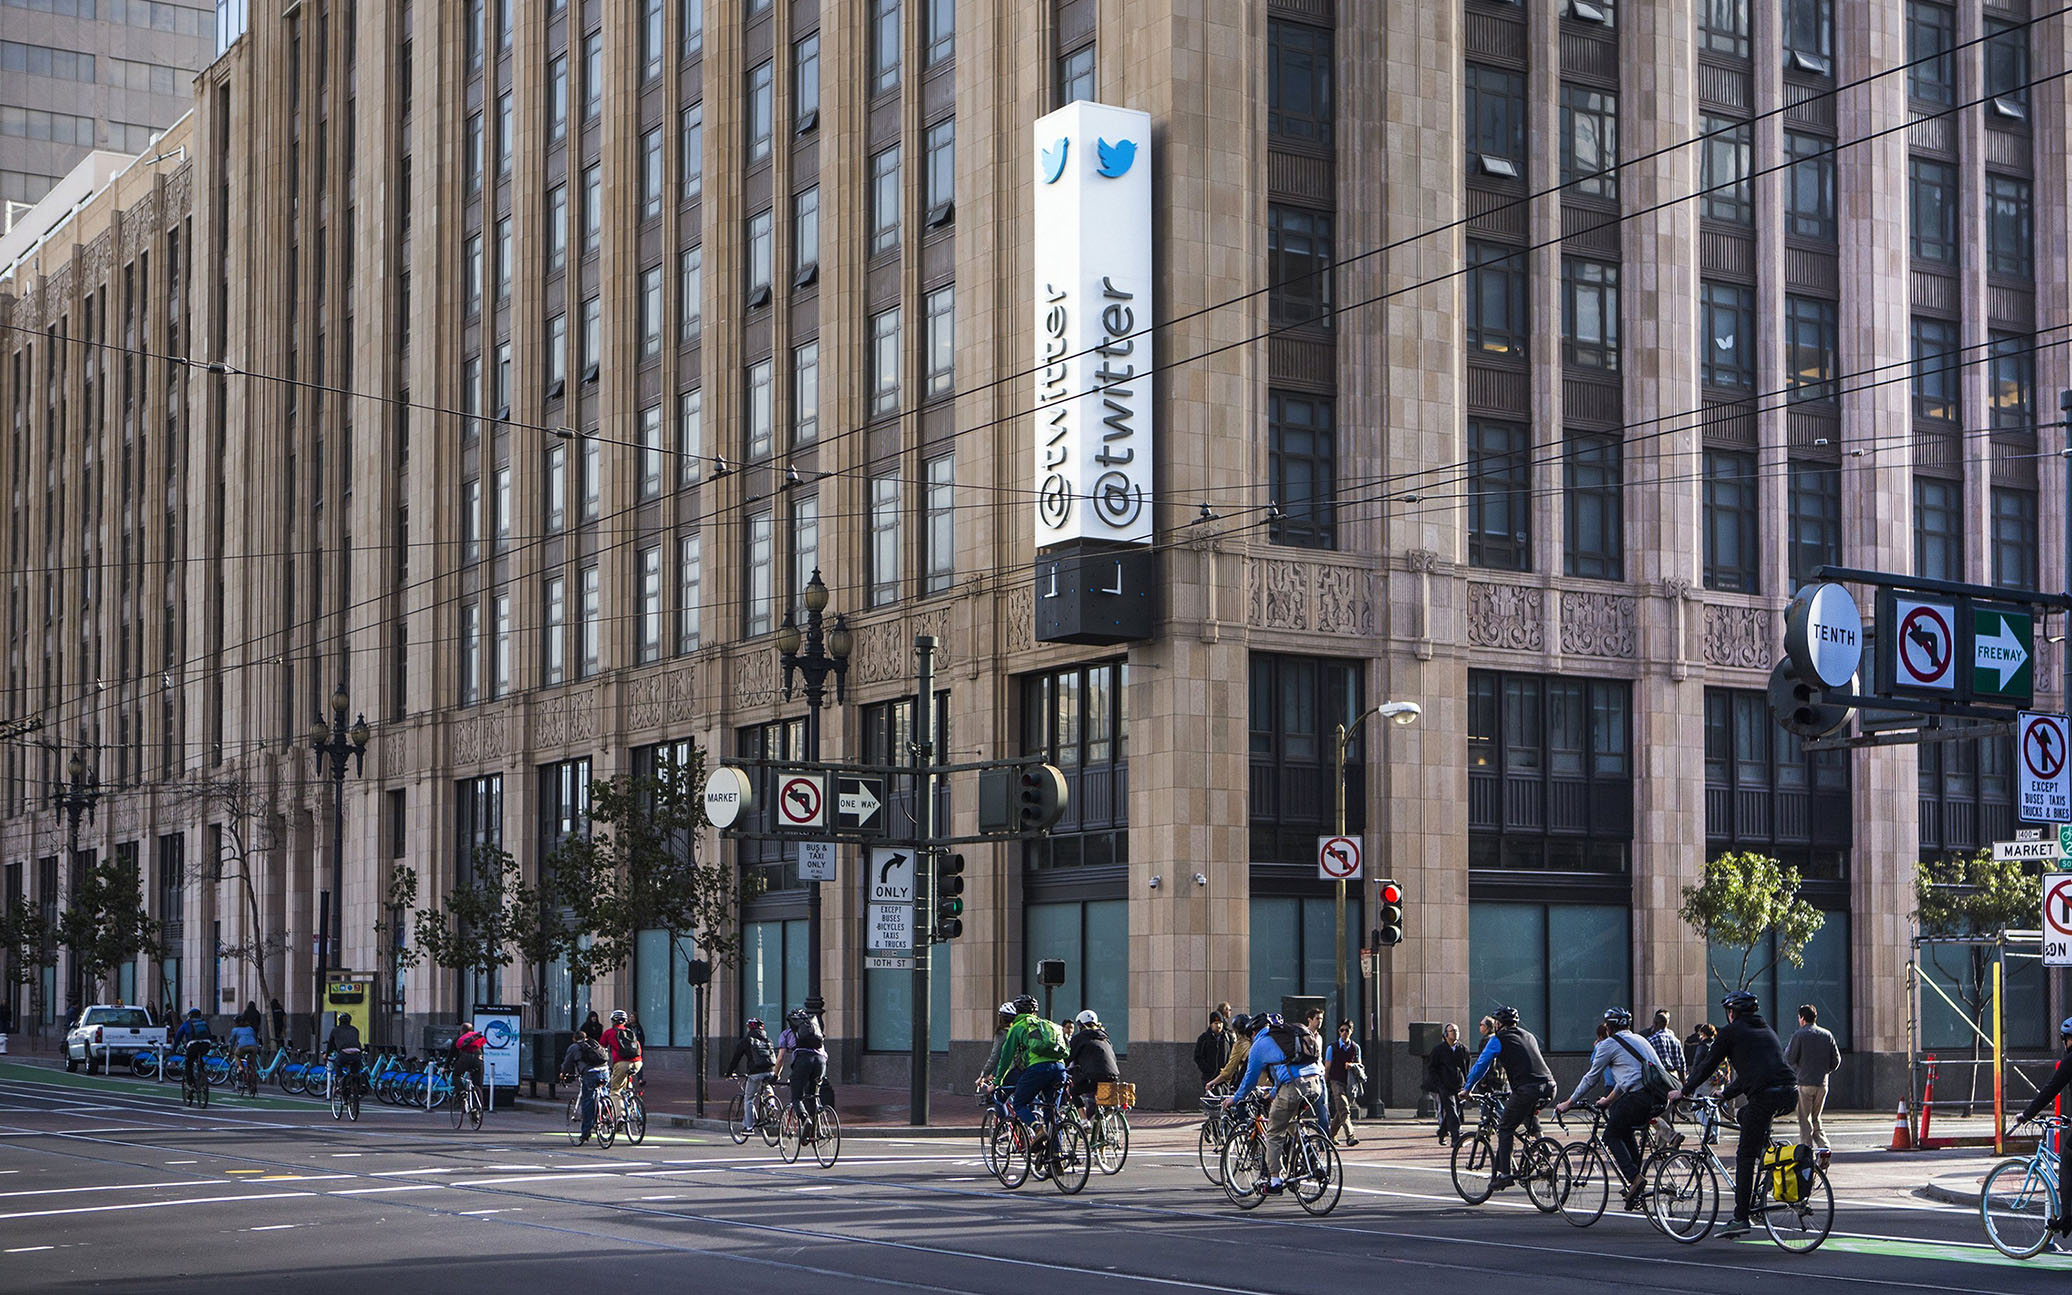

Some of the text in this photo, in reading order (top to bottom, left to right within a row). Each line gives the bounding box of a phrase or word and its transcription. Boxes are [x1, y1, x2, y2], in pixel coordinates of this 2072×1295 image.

[1040, 283, 1071, 529] @twitter
[1093, 276, 1142, 528] @twitter
[1813, 623, 1855, 646] TENTH
[1978, 645, 2022, 662] FREEWAY
[2031, 780, 2059, 793] EXCEPT
[707, 792, 738, 803] MARKET
[2025, 793, 2066, 806] BUSES TAXIS
[840, 800, 877, 809] ONE WAY
[2022, 805, 2070, 820] TRUCKS & BIKES
[2004, 843, 2054, 857] MARKET
[807, 861, 826, 869] ONLY
[876, 886, 908, 898] ONLY
[880, 905, 902, 914] EXCEPT
[881, 914, 901, 923] BUSES
[877, 923, 905, 931] BICYCLES
[883, 932, 899, 940] TAXIS
[875, 940, 907, 948] & TRUCKS
[873, 958, 906, 968] 10TH ST
